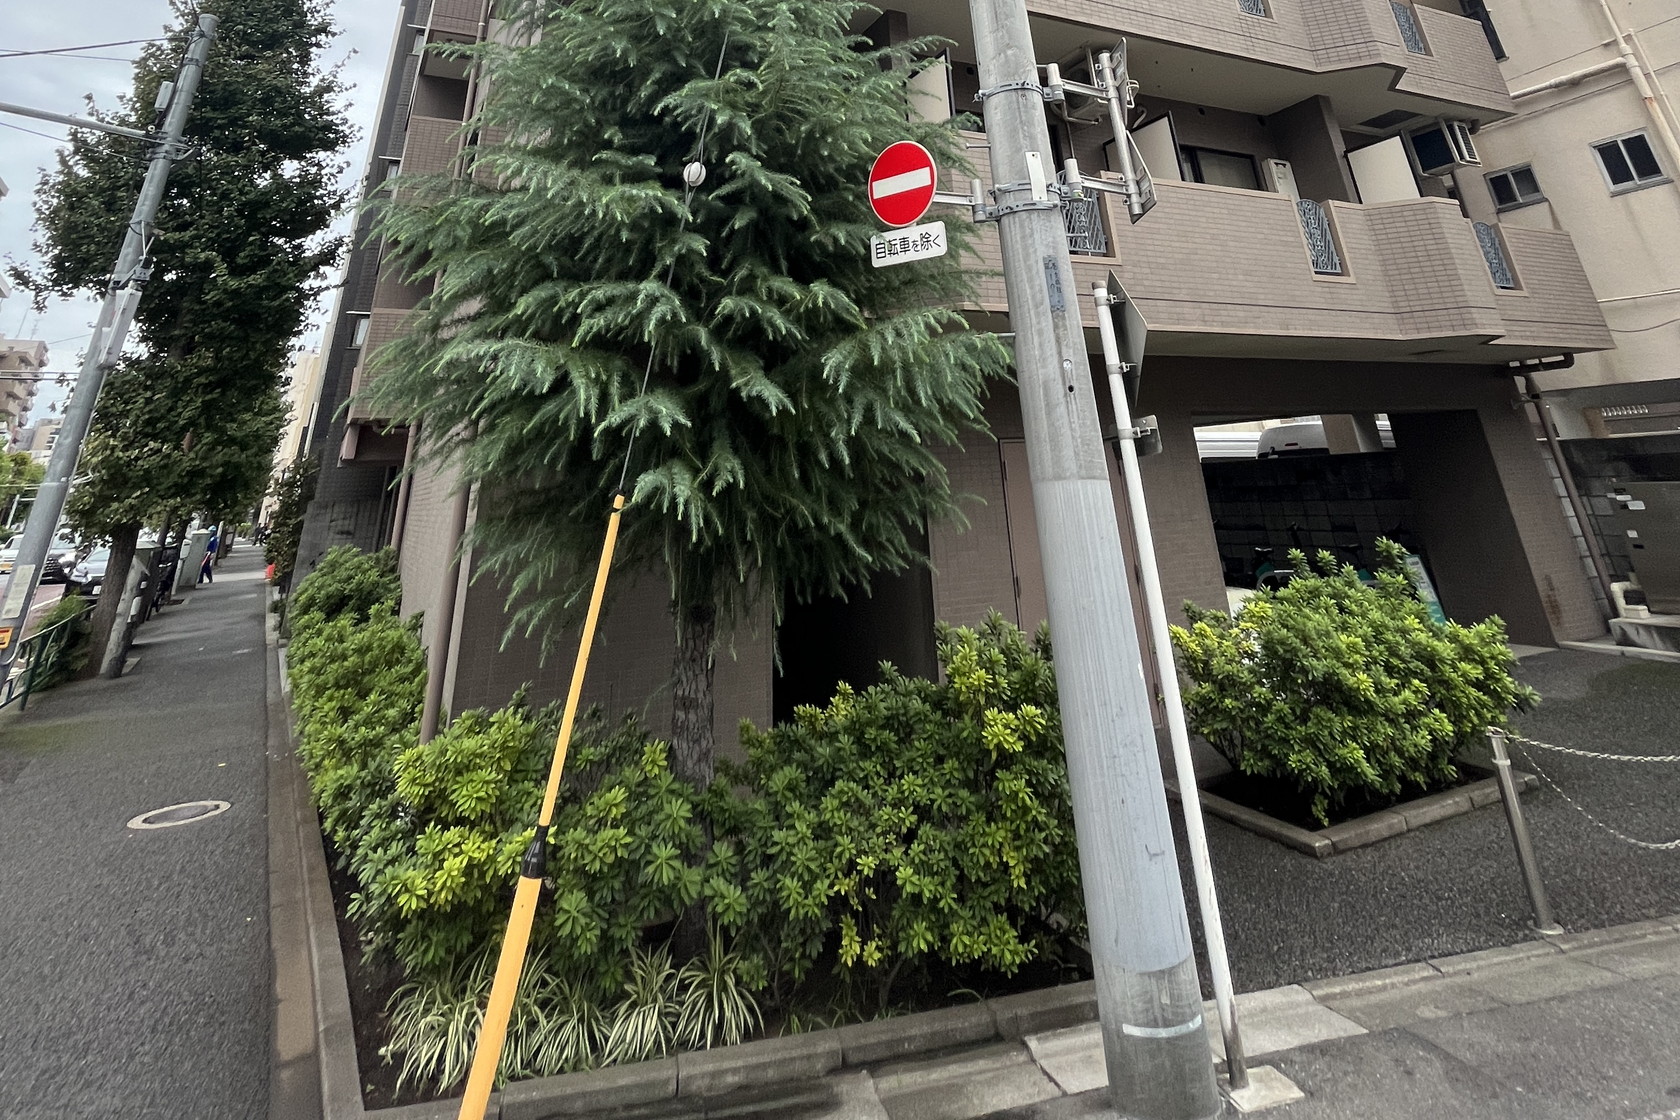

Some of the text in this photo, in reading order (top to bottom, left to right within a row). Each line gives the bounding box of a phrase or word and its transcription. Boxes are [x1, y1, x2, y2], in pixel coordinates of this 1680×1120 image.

[875, 232, 941, 259] 自転車を除く
